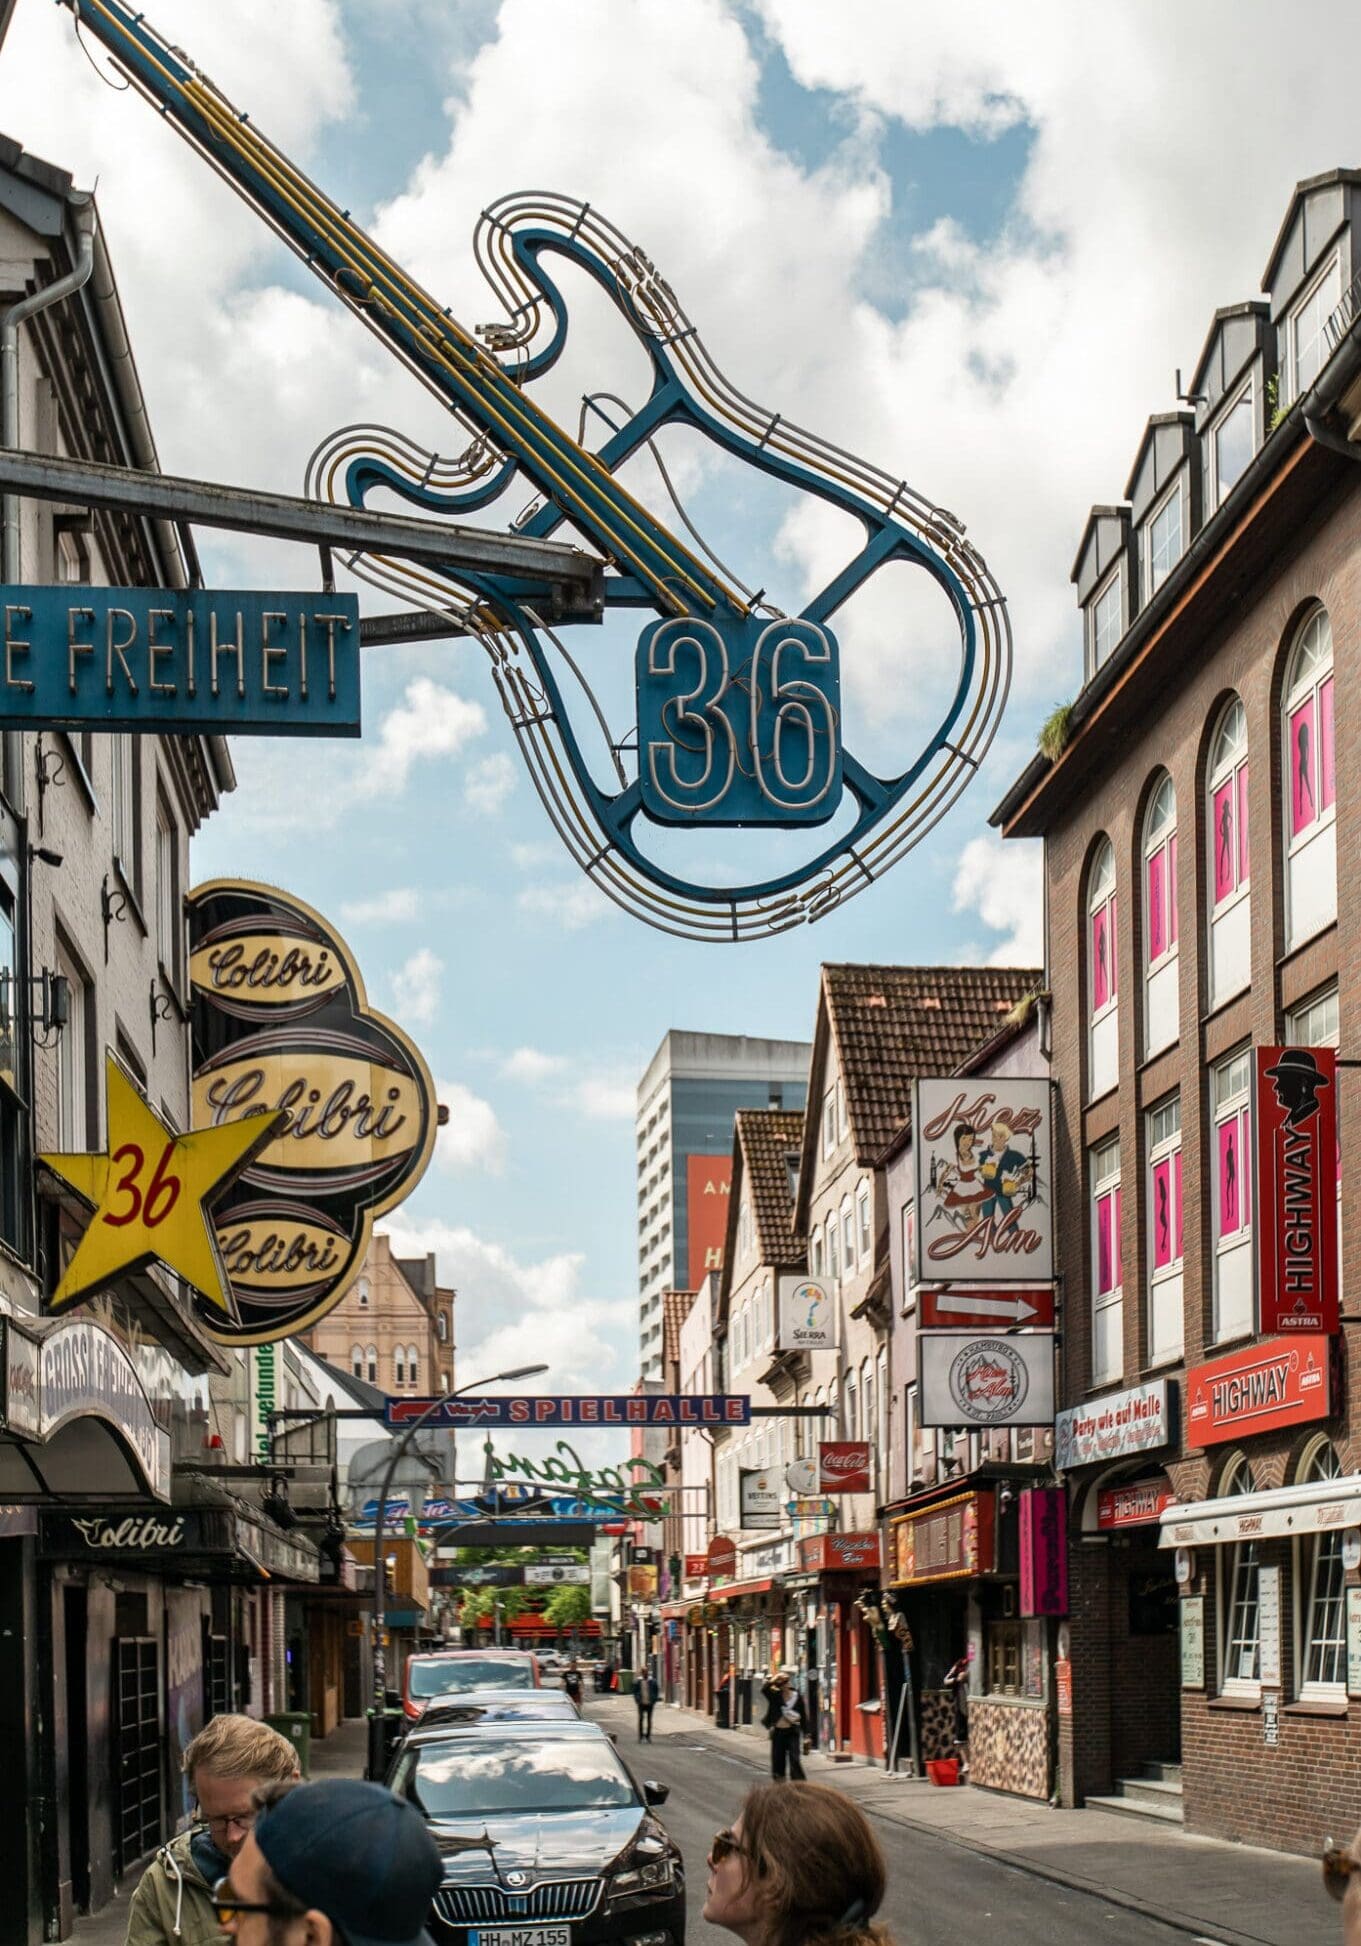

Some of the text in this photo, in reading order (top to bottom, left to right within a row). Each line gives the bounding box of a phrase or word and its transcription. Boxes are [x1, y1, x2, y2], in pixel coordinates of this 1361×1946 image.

[68, 606, 353, 699] FREIHEIT
[648, 617, 836, 811] 36
[208, 942, 333, 989] Colibri
[102, 1142, 181, 1229] 36
[1284, 1124, 1313, 1293] HIGHWAY
[219, 1229, 339, 1274] Colibri
[927, 1206, 1043, 1261] Alm
[1281, 1317, 1320, 1327] ASTRA
[509, 1400, 744, 1421] SPIELHALLE
[1212, 1362, 1291, 1418] HIGHWAY
[1073, 1394, 1161, 1437] Party wie auf Malle
[1114, 1488, 1160, 1519] HIGHWAY
[479, 1929, 568, 1946] HH MZ 155
